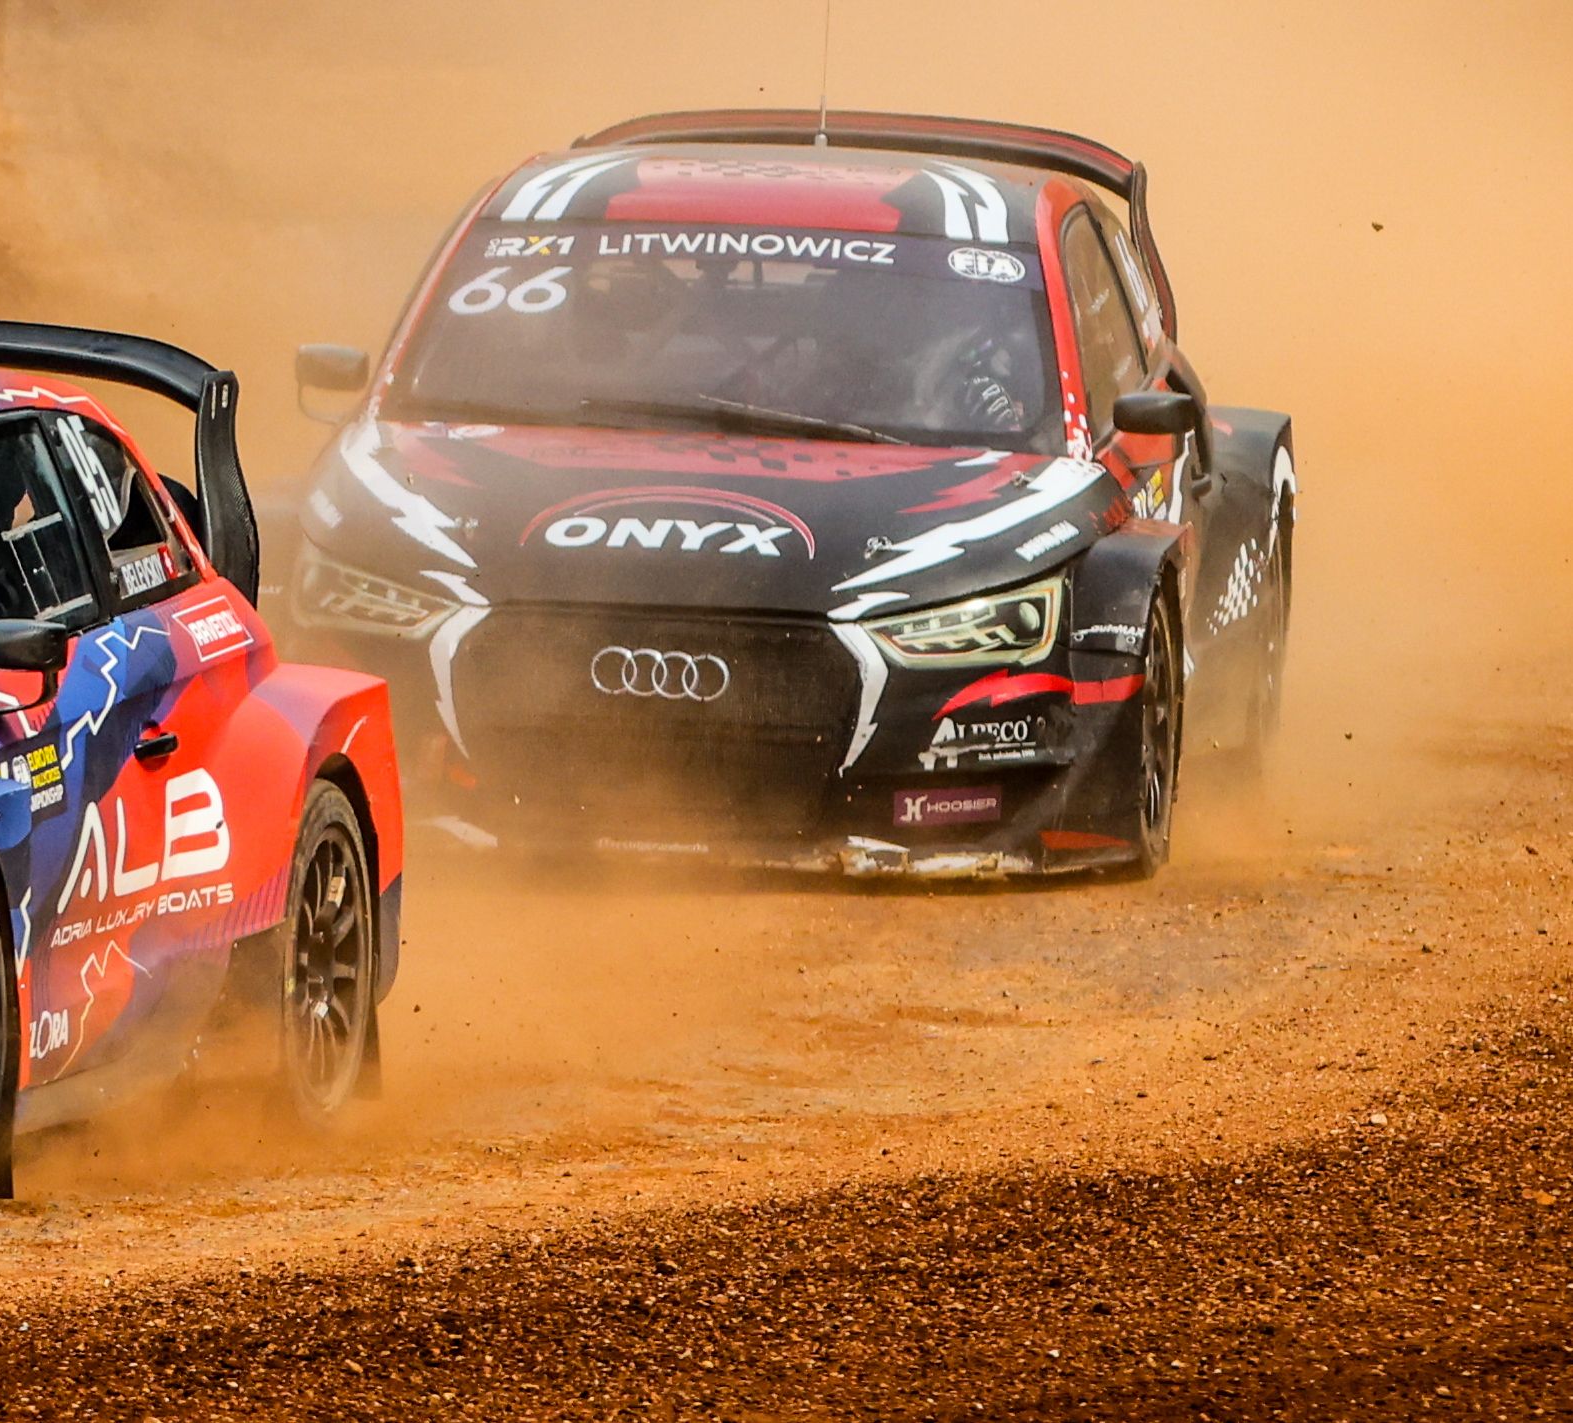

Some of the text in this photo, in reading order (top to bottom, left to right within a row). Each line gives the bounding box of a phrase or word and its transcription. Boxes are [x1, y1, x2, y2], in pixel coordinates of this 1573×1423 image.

[496, 235, 575, 256] RX1
[598, 232, 897, 265] LITWINOWICZ
[953, 252, 1021, 279] FIA
[448, 266, 573, 314] 66
[56, 414, 123, 531] 95
[544, 516, 793, 558] ONYX
[926, 797, 997, 813] HOOSIER
[57, 767, 231, 915] ALB
[50, 918, 93, 949] ADRIA
[157, 882, 235, 916] BOATS
